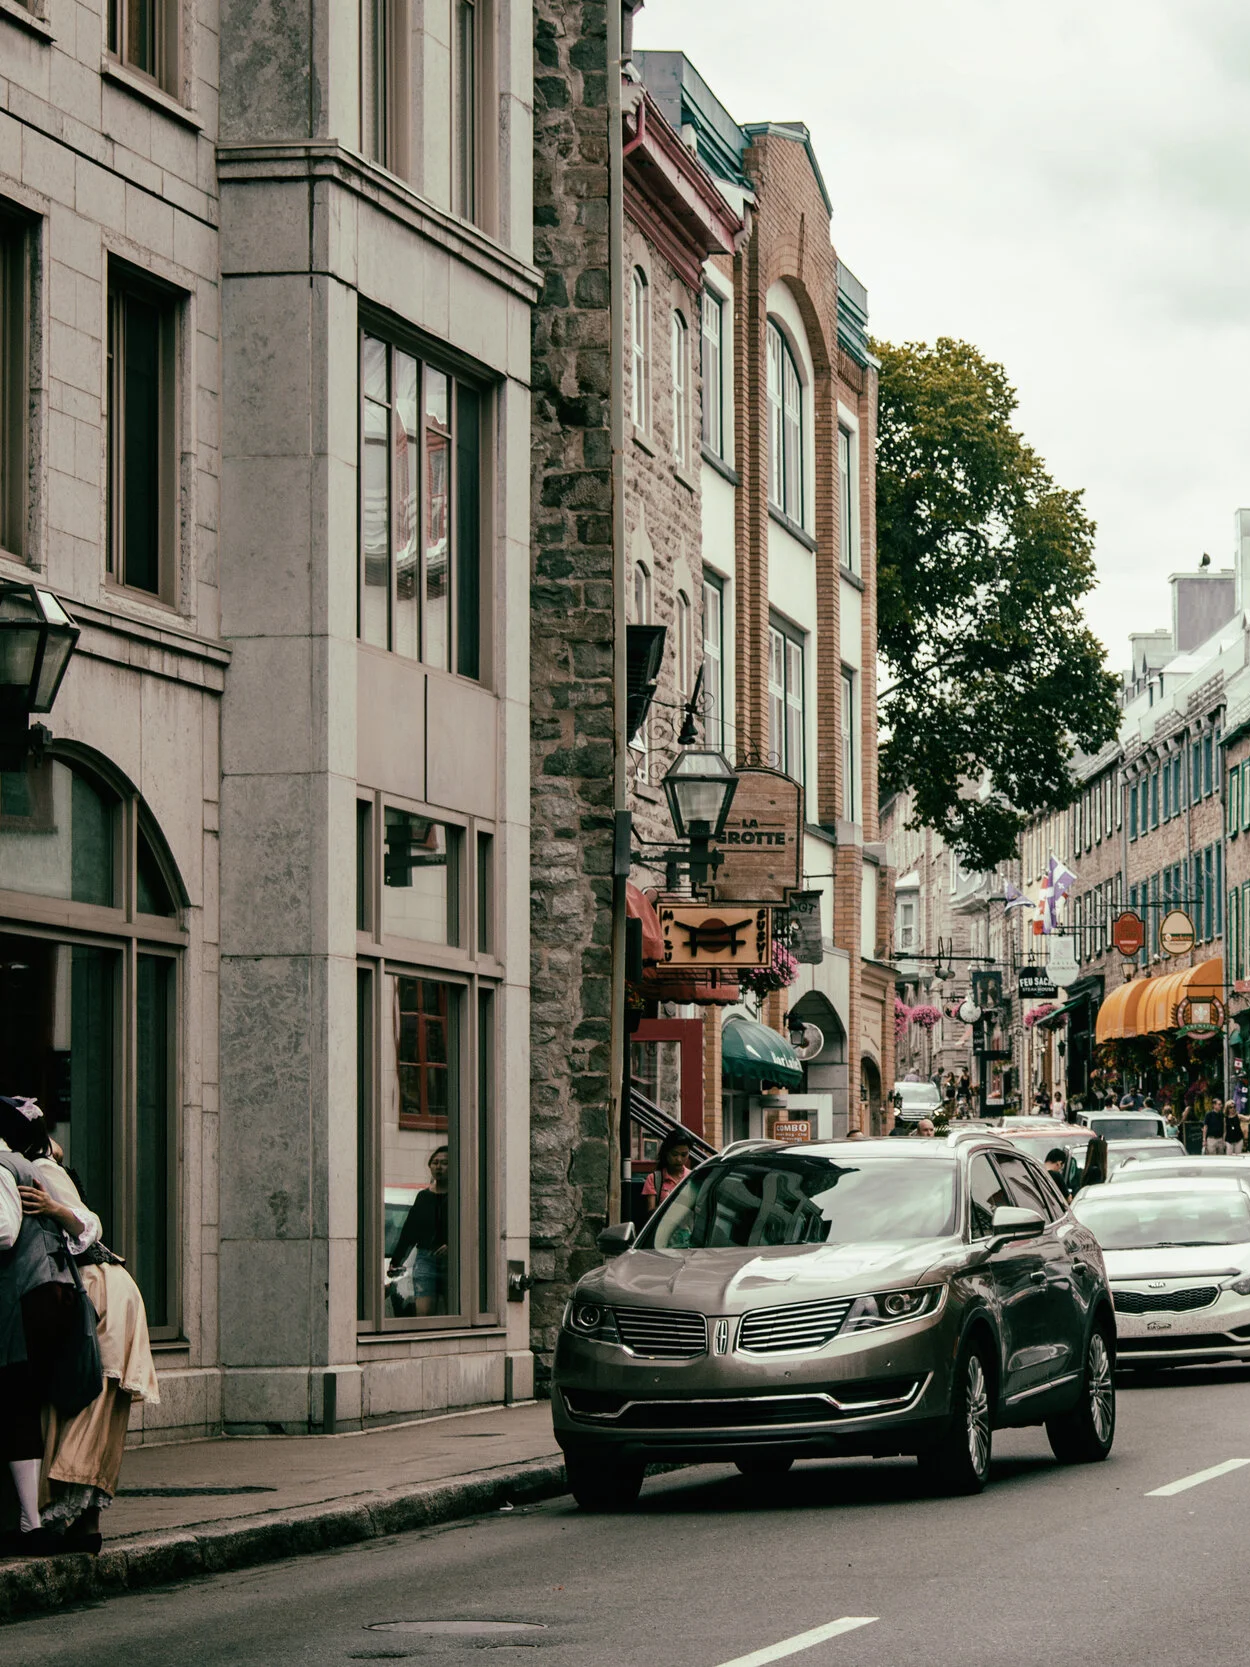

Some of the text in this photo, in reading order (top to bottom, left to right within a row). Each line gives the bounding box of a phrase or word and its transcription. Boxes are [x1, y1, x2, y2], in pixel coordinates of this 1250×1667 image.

[741, 818, 759, 829] LA
[716, 831, 786, 845] GROTTE
[662, 909, 674, 962] MIZU
[1019, 977, 1034, 987] FEU
[776, 1123, 808, 1132] COMBO
